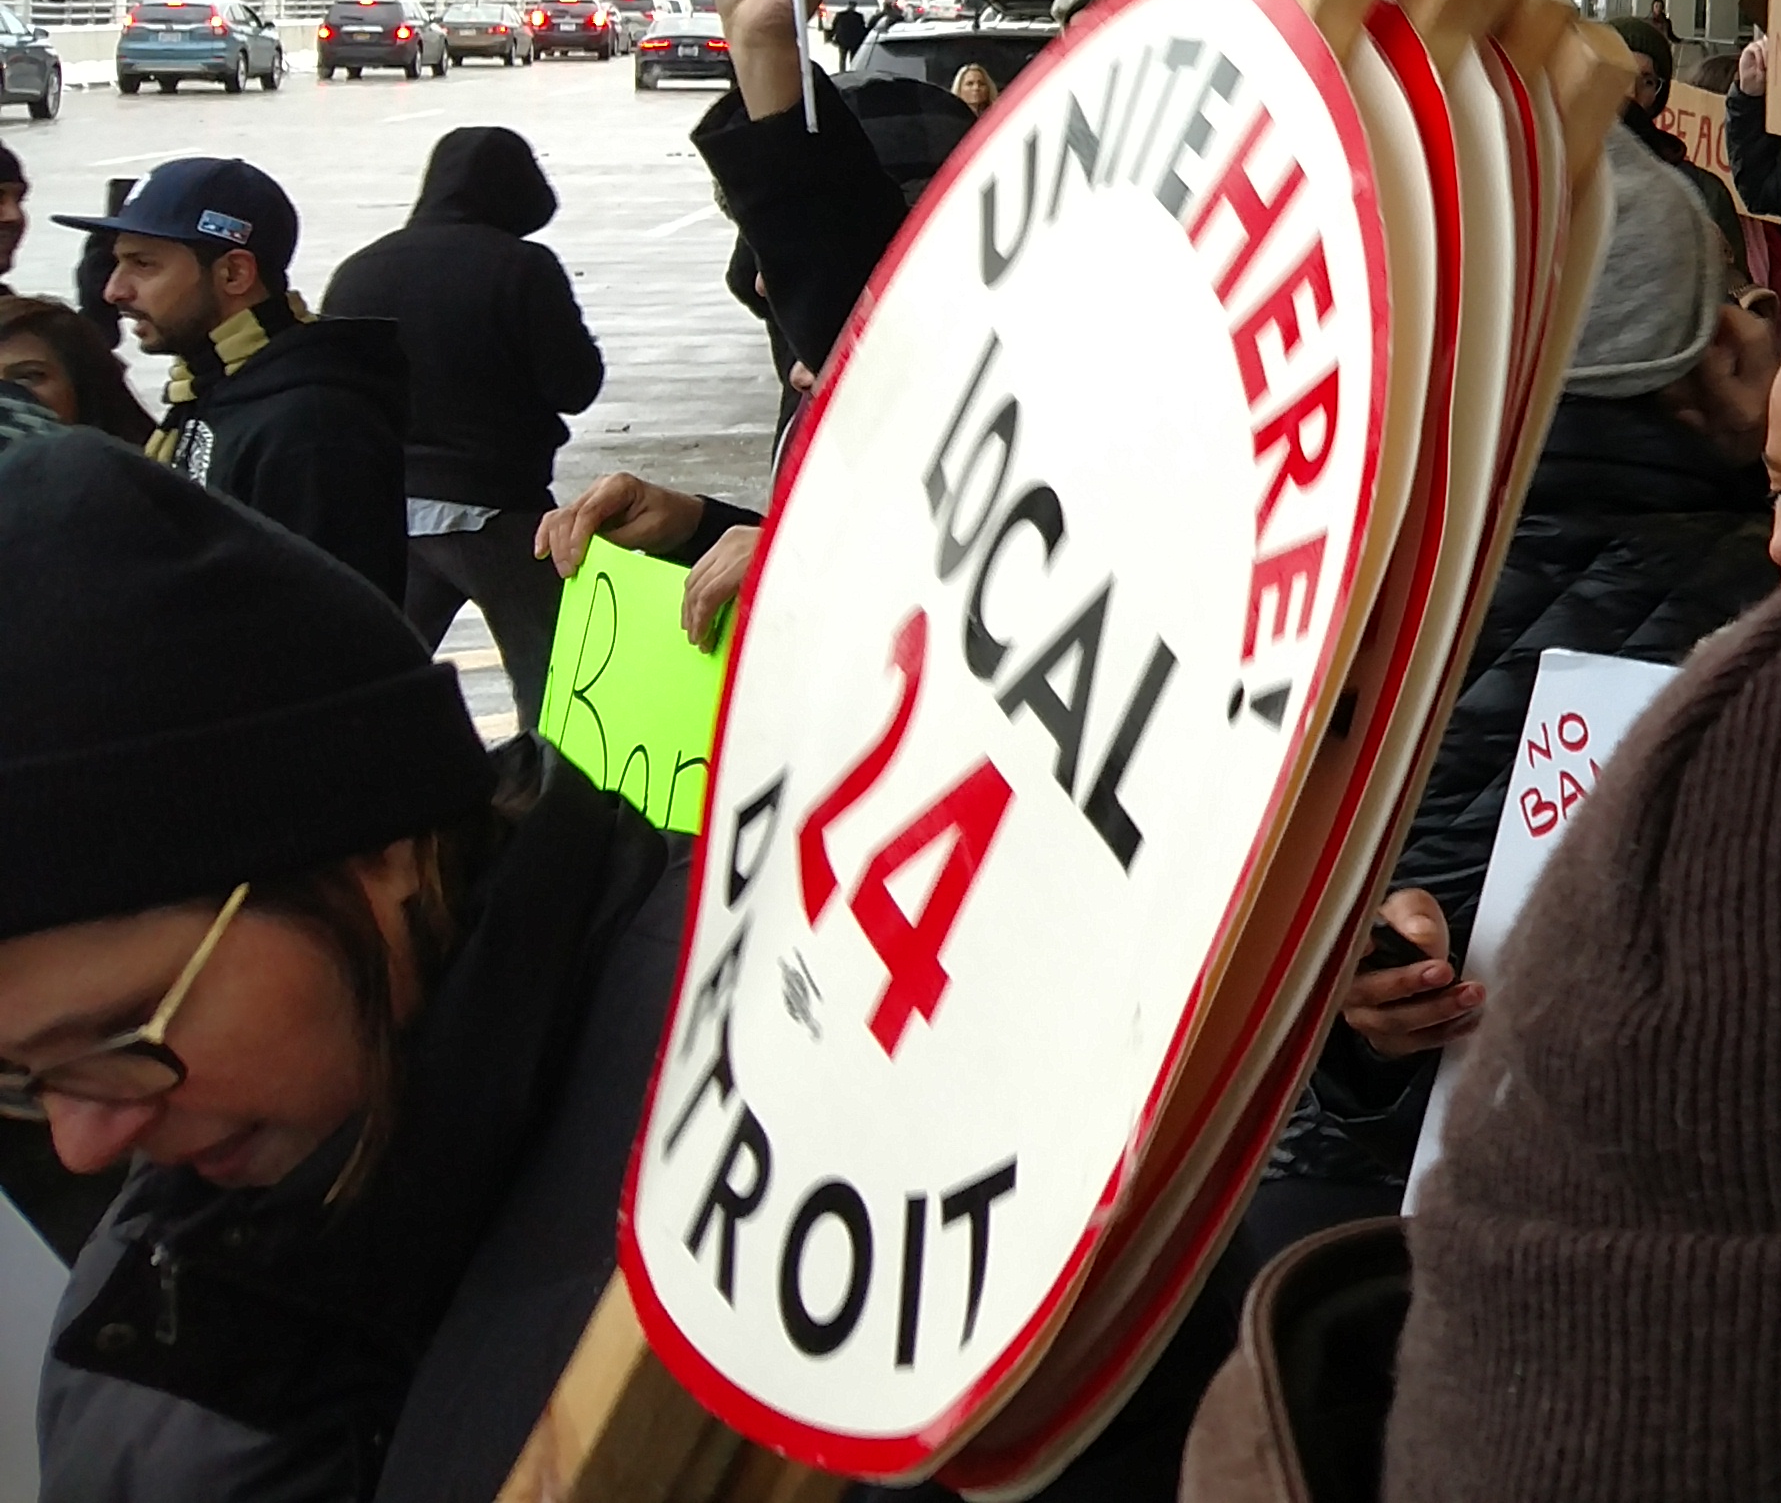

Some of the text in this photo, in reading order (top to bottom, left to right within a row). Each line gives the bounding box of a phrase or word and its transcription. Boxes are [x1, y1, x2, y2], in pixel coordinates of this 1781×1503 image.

[922, 327, 1179, 877] LOCAL
[1527, 712, 1590, 769] NO
[795, 606, 1016, 1063] 24
